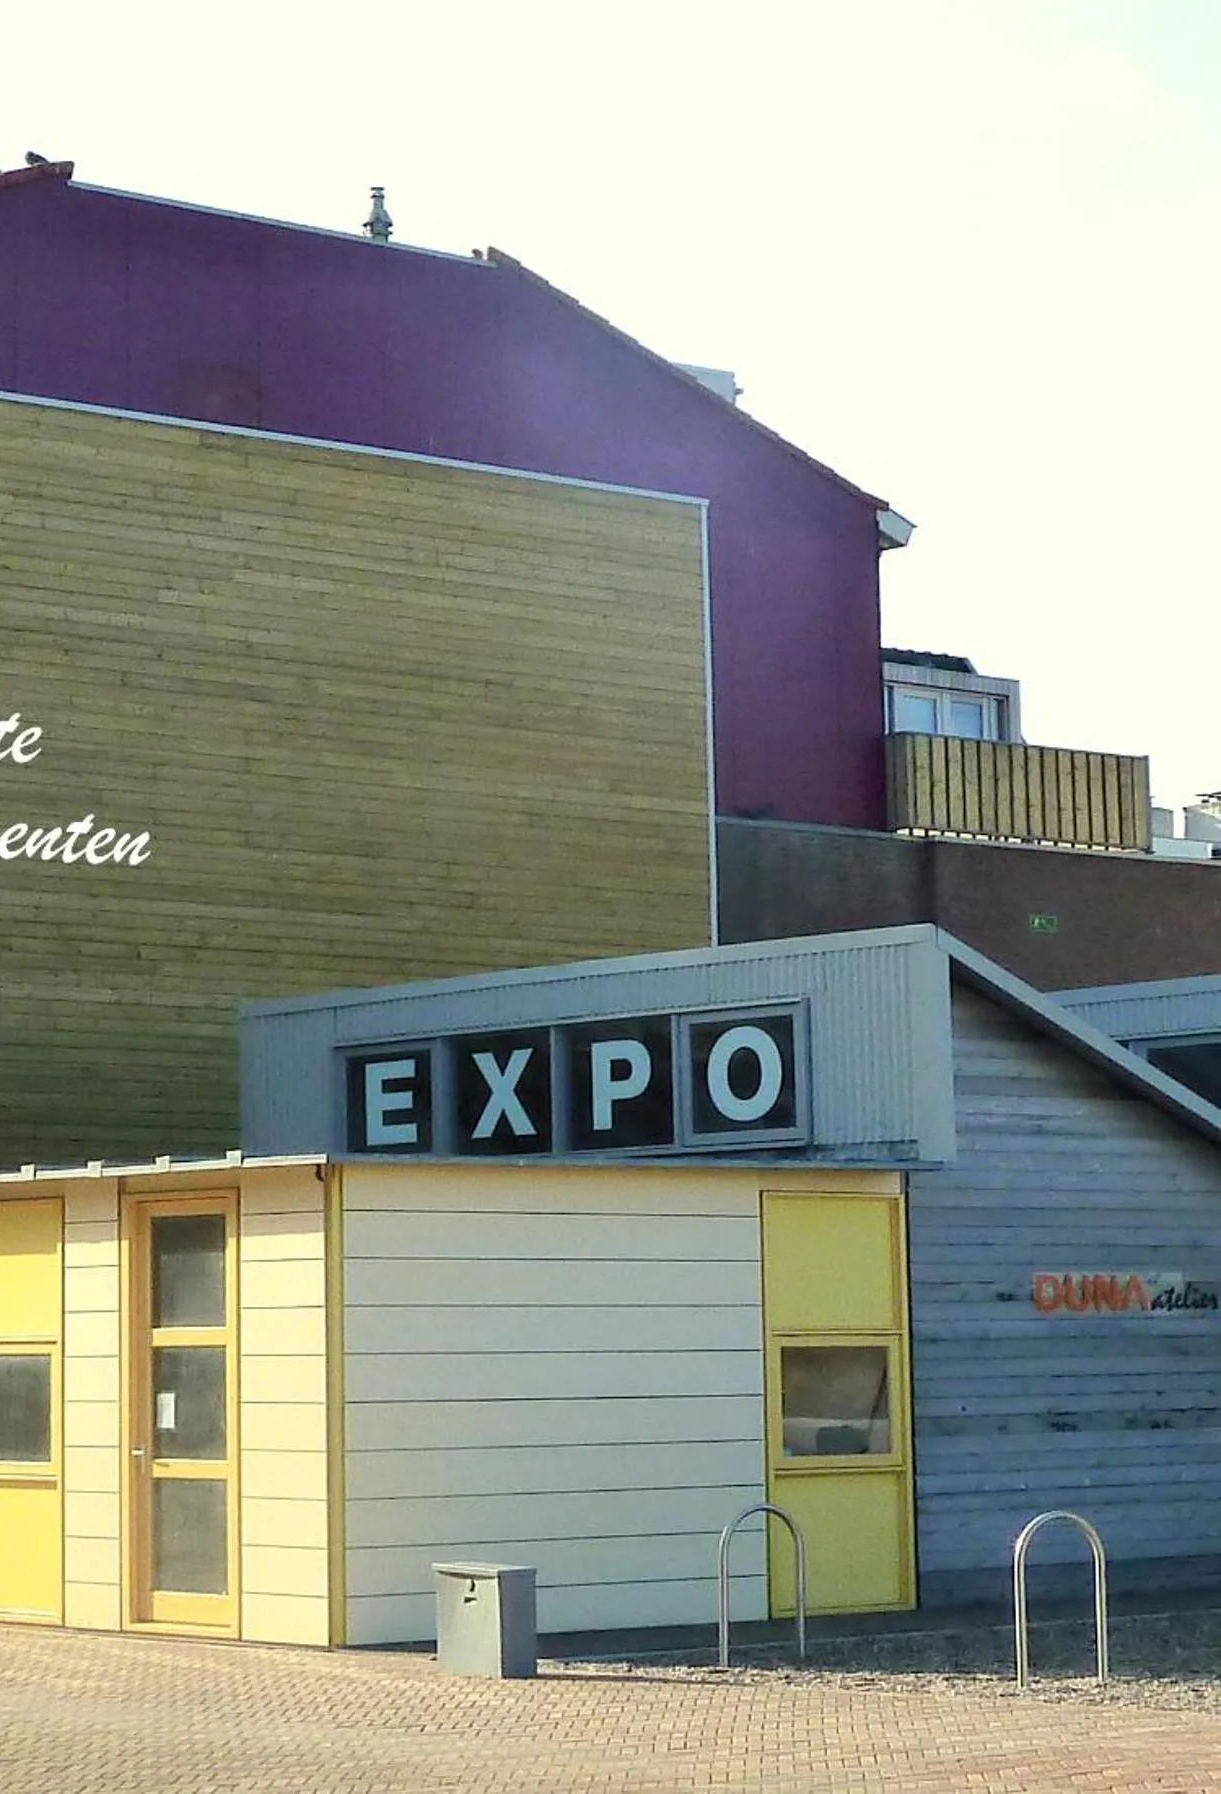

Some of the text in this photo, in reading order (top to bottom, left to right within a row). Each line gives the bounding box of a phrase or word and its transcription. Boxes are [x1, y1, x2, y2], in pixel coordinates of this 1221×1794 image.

[365, 1024, 783, 1147] EXPO
[1033, 1273, 1219, 1313] DUNA atelier
